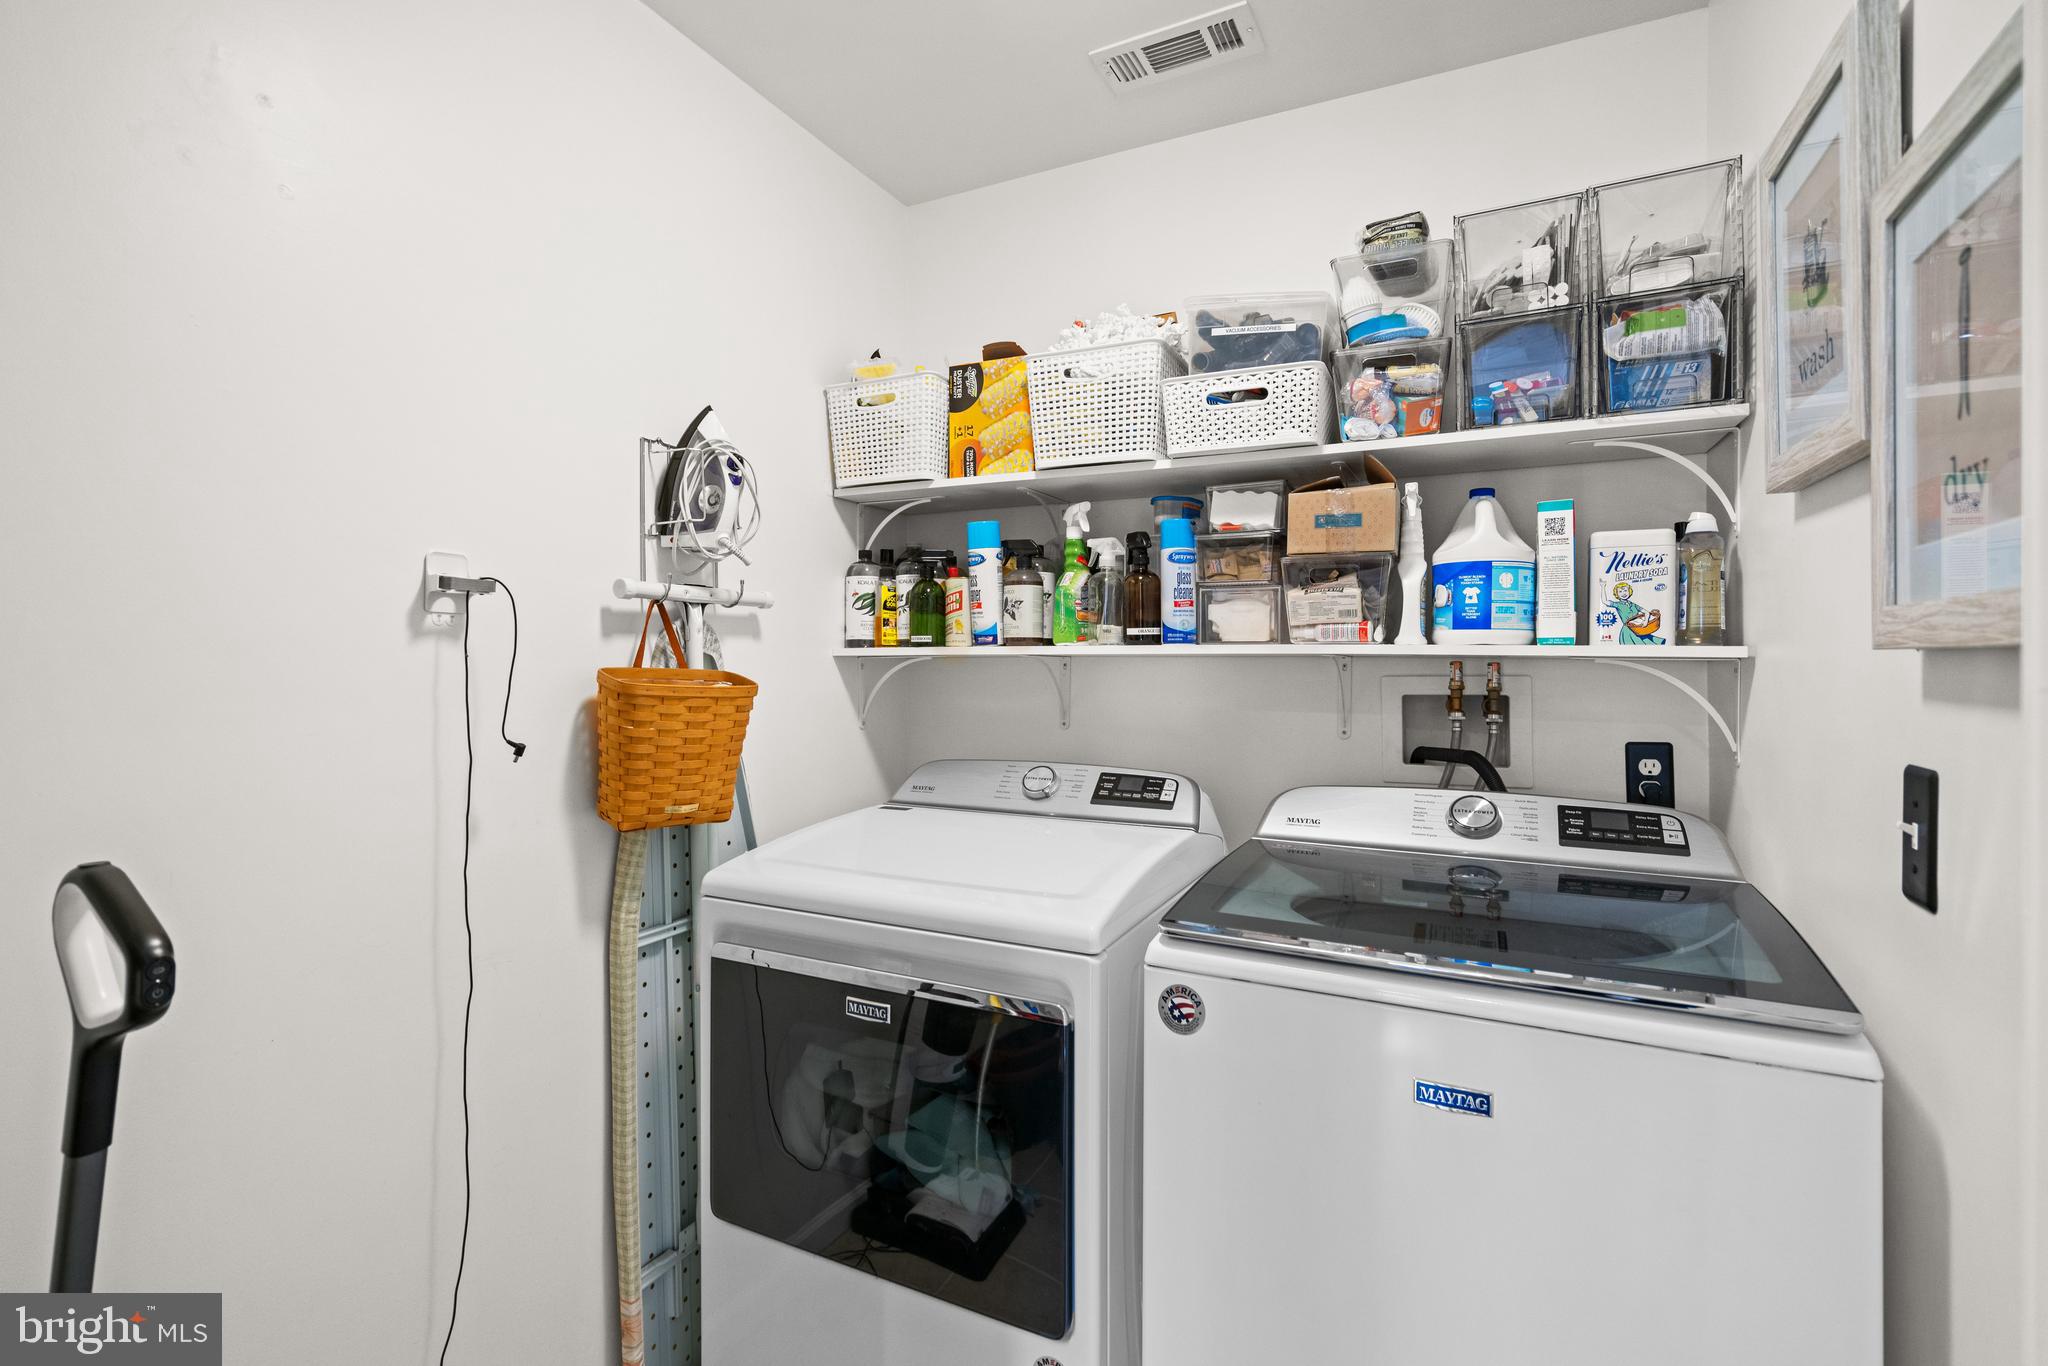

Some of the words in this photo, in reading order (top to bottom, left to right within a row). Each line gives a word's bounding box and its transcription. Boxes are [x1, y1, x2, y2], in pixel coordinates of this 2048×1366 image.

[1246, 325, 1282, 333] ACCESSORIES
[1797, 327, 1836, 385] wash
[1684, 362, 1699, 373] 13
[966, 424, 974, 437] 17
[1943, 456, 1990, 506] dry
[1599, 551, 1666, 574] Nellie's
[1176, 570, 1192, 586] glass
[1615, 569, 1649, 582] LAUNDRY
[1649, 567, 1669, 577] SODA
[1173, 587, 1194, 600] cleaner
[1286, 817, 1321, 825] MAYTAG
[1161, 986, 1202, 1009] AMERICA
[848, 1002, 887, 1019] MAYTAG
[1419, 1086, 1488, 1111] MAYTAG
